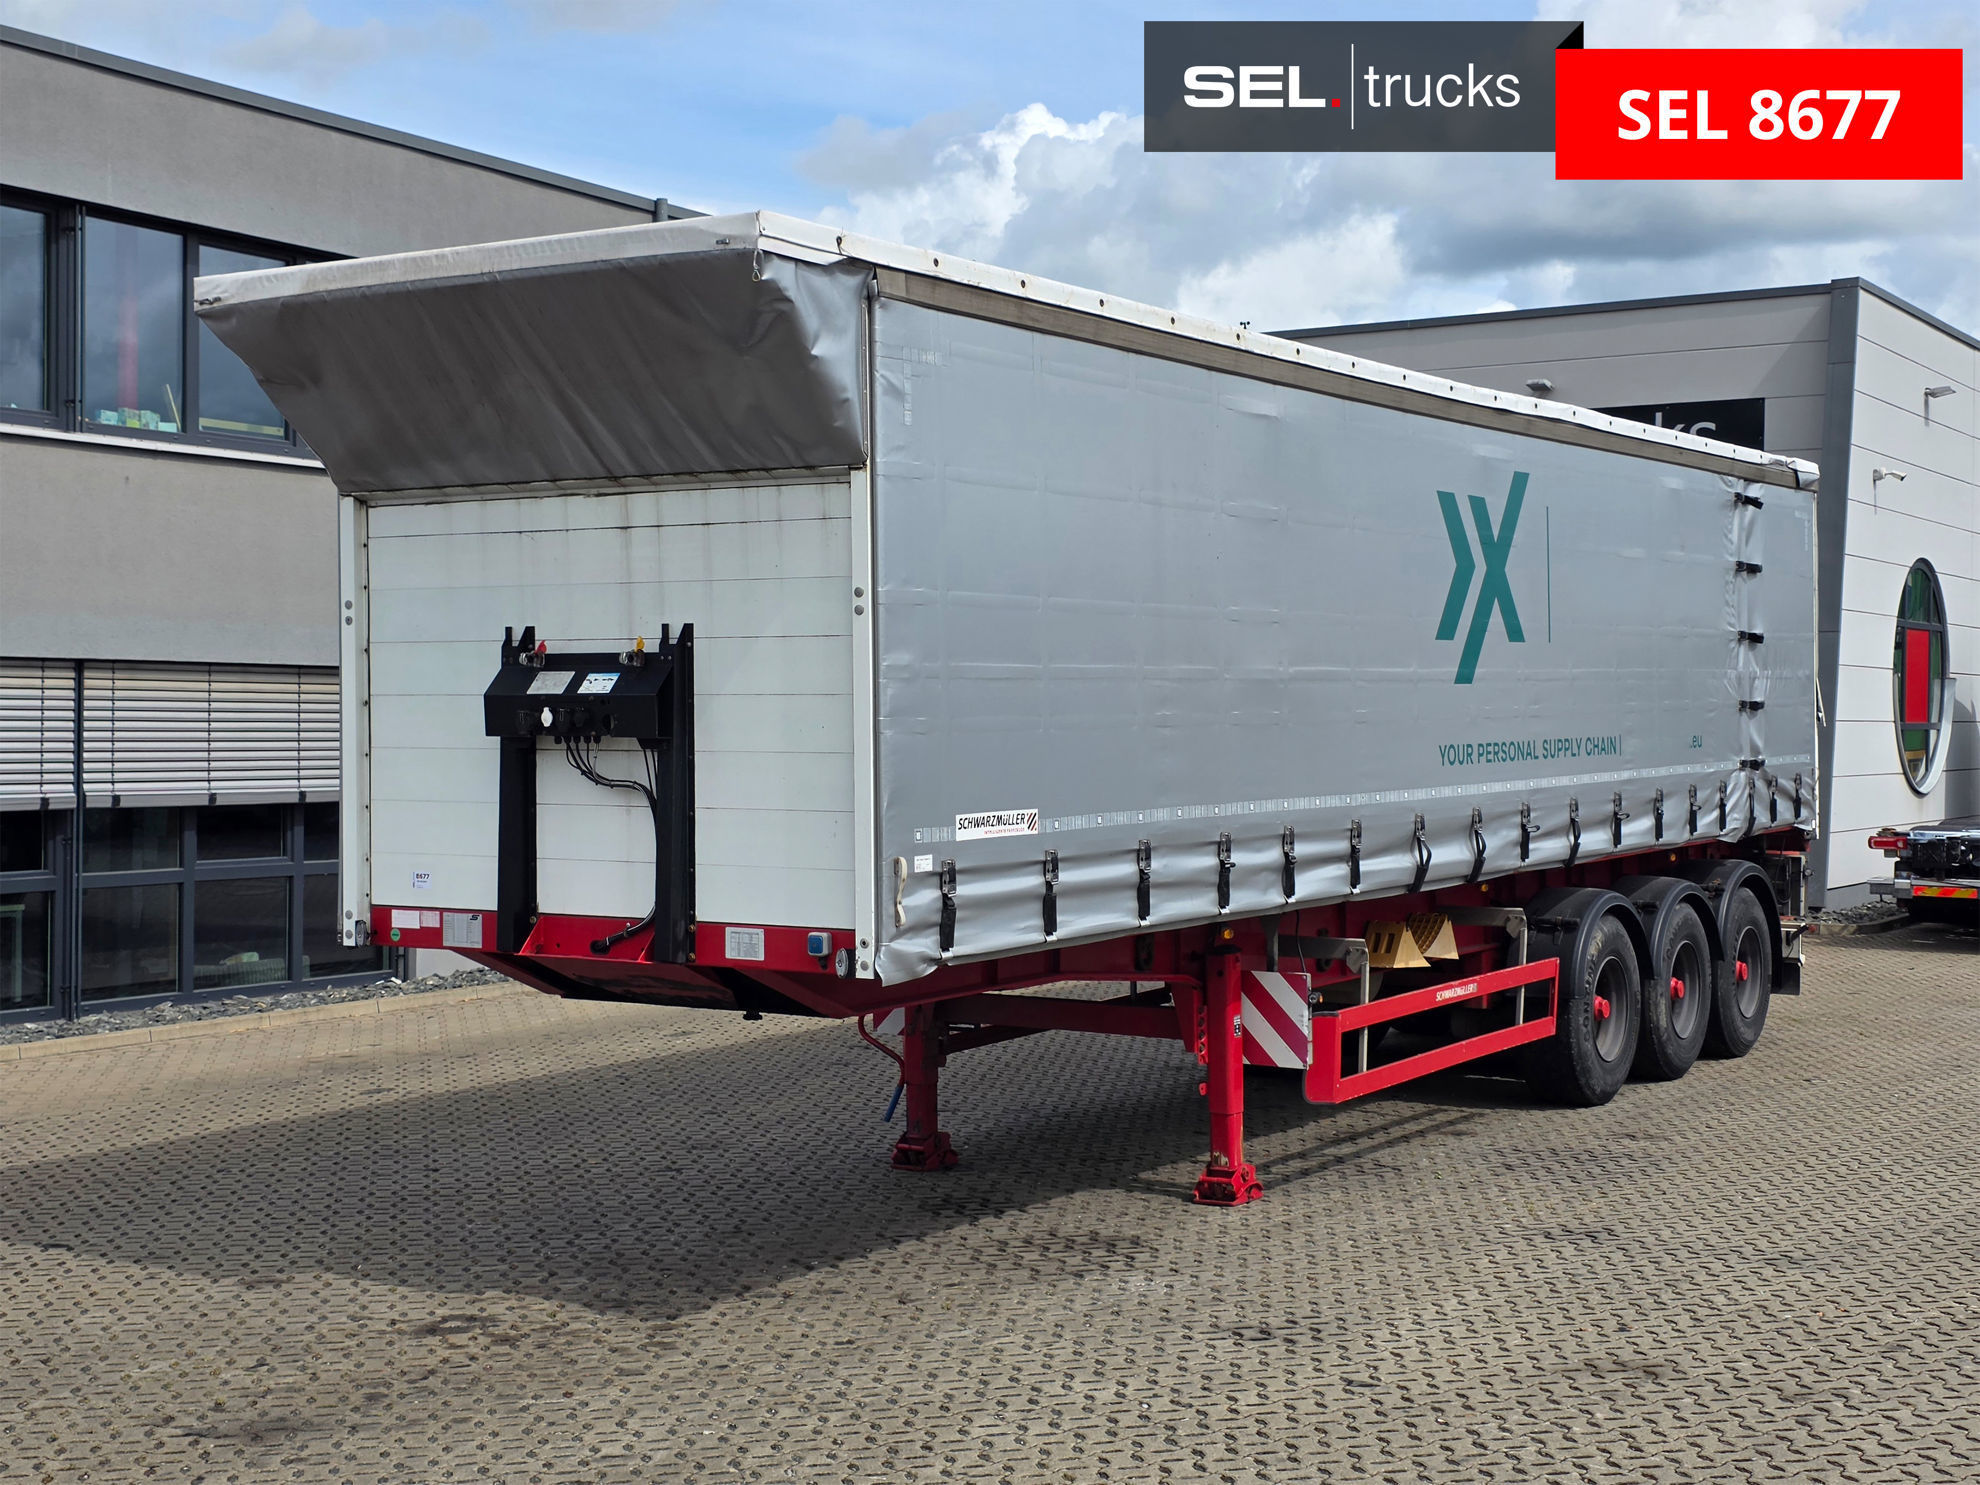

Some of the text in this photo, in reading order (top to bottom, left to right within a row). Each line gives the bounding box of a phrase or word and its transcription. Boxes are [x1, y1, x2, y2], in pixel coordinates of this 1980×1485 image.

[1438, 735, 1617, 767] YOUR PERSONAL SUPPLY CHAIN
[957, 812, 1026, 831] SCHWARZMÜLLER
